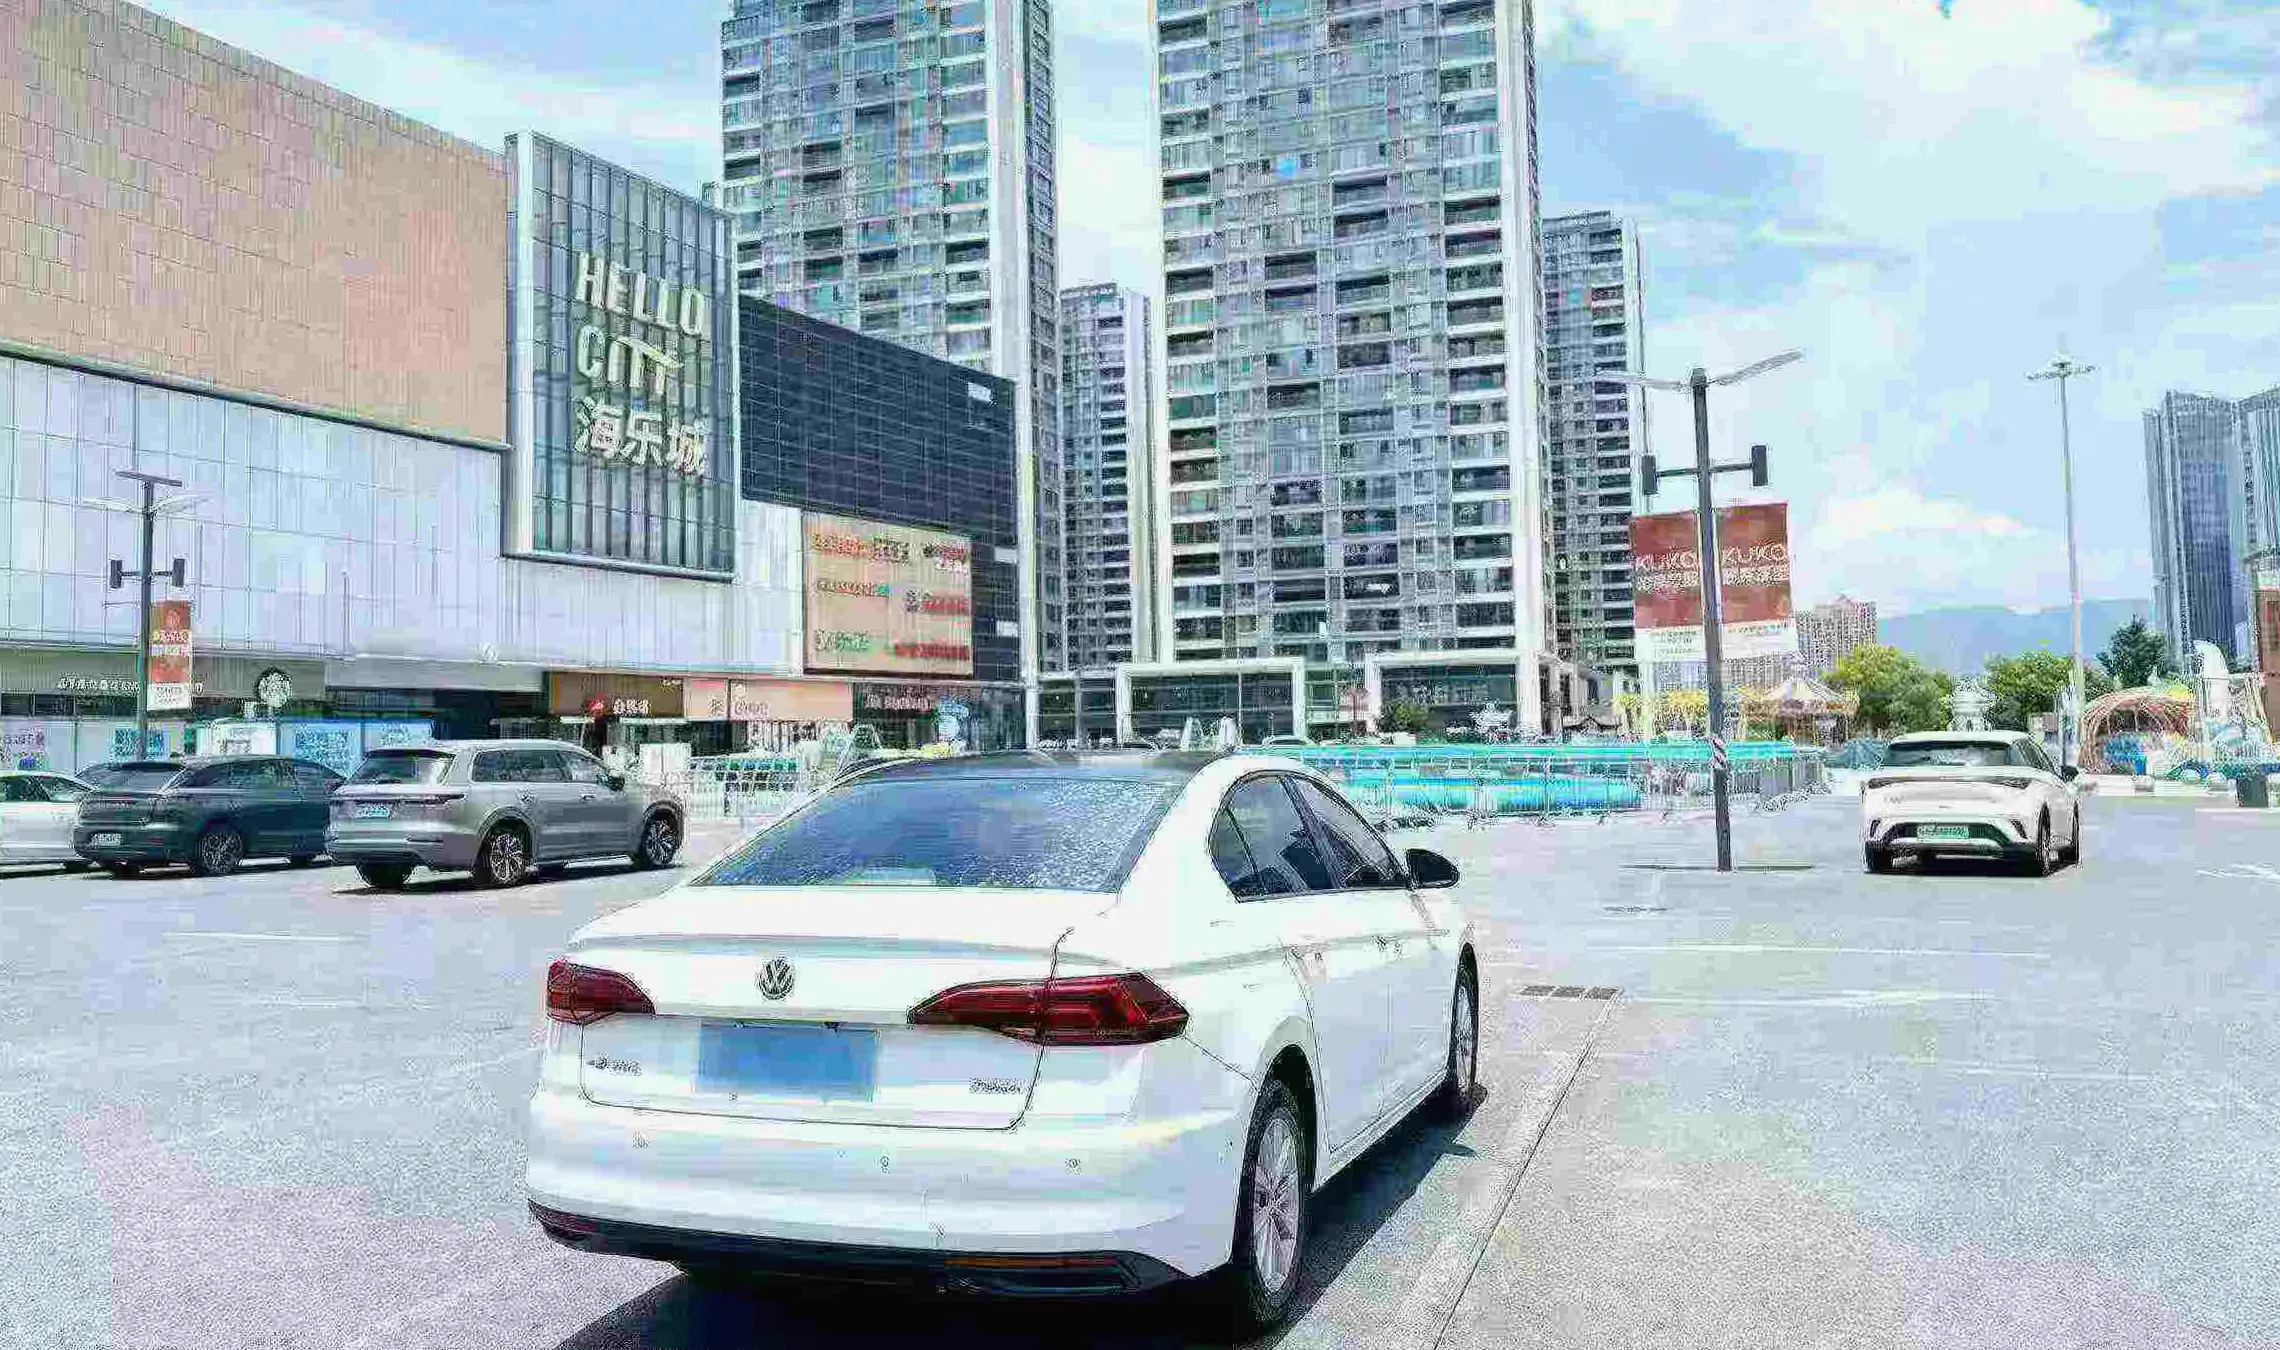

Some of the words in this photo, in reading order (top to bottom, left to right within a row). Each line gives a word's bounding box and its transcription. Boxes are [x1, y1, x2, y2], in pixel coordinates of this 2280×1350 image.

[576, 252, 705, 336] HELLO
[577, 325, 684, 395] CITY
[572, 396, 711, 475] 海乐城
